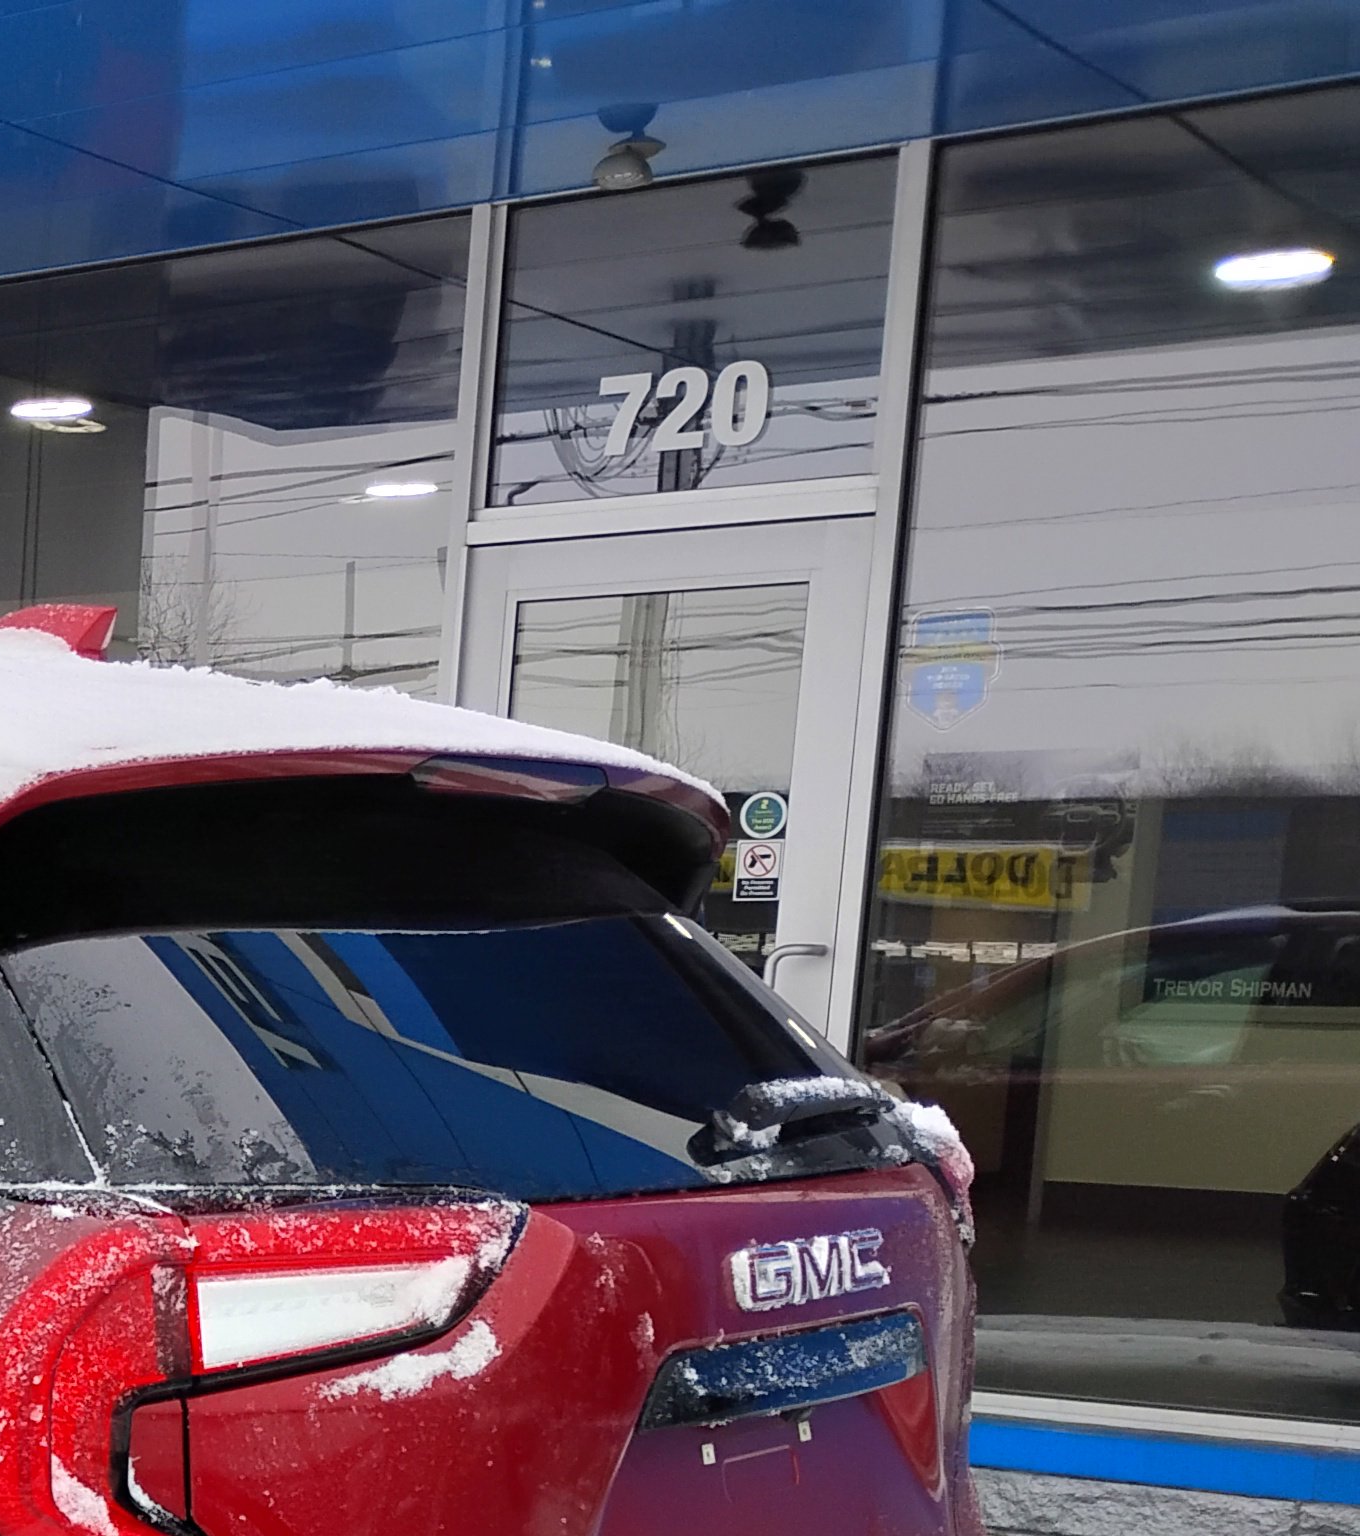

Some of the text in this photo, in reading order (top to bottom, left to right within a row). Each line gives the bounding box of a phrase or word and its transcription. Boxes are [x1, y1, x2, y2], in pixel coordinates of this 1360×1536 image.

[599, 360, 769, 456] 720
[1153, 978, 1313, 998] TREVOR SHIPMAN
[730, 1228, 891, 1311] GMC
